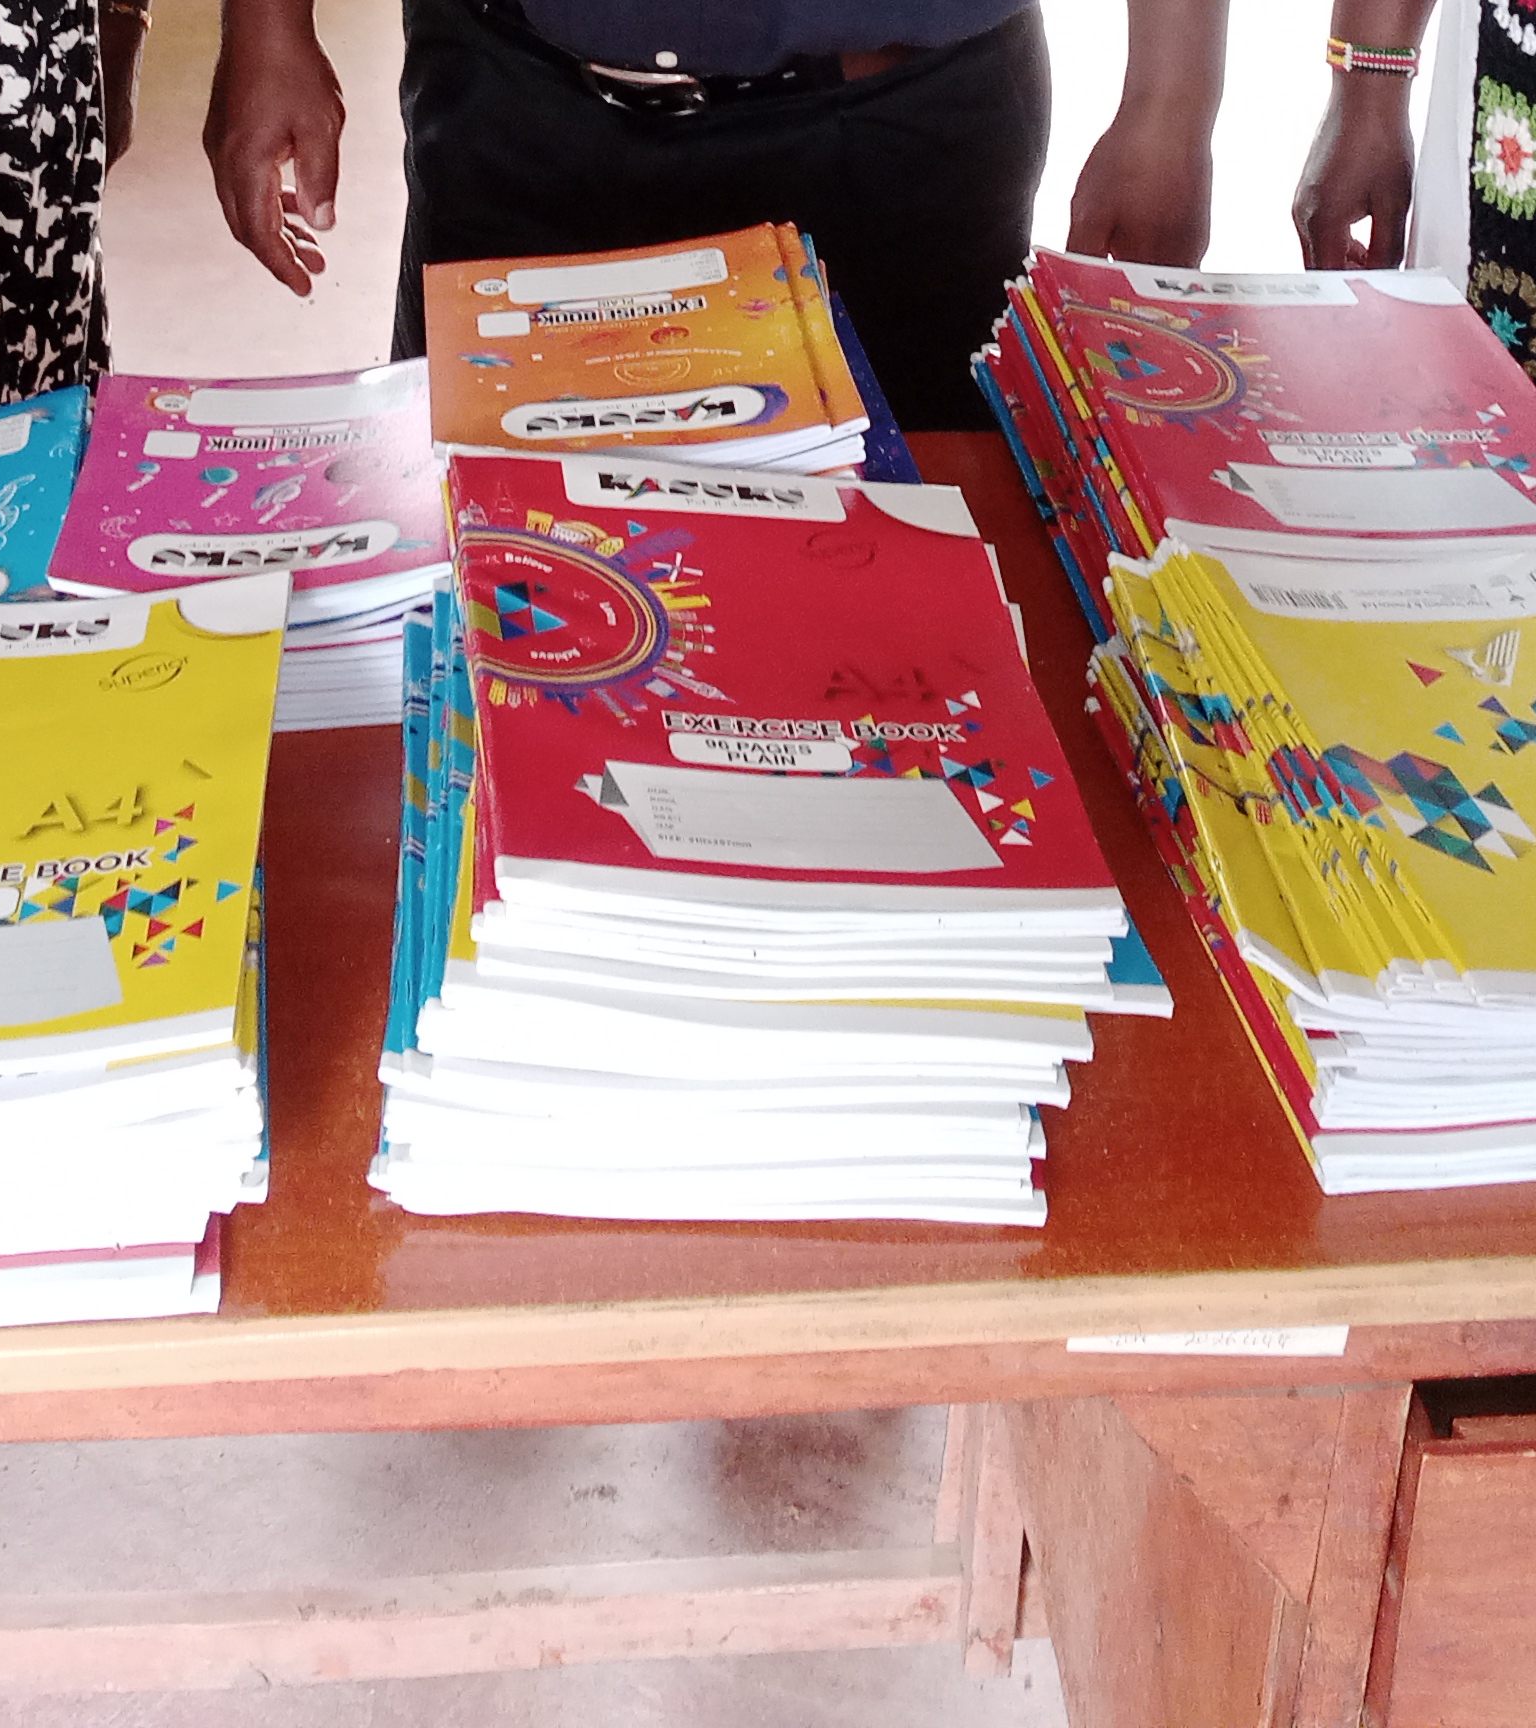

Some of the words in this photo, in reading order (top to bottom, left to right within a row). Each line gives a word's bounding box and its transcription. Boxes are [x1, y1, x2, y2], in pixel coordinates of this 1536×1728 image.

[537, 307, 598, 328] BOOK
[601, 295, 706, 321] EXERCISE
[526, 396, 736, 435] KASUKU
[204, 435, 271, 453] BOOK
[598, 472, 805, 502] KASUKU
[151, 532, 369, 568] KASUKU
[662, 710, 845, 740] EXERCISE
[850, 720, 966, 743] BOOK
[727, 751, 796, 766] PLAIN
[736, 740, 812, 756] PAGES
[15, 783, 146, 842] A4
[35, 847, 155, 881] BOOK
